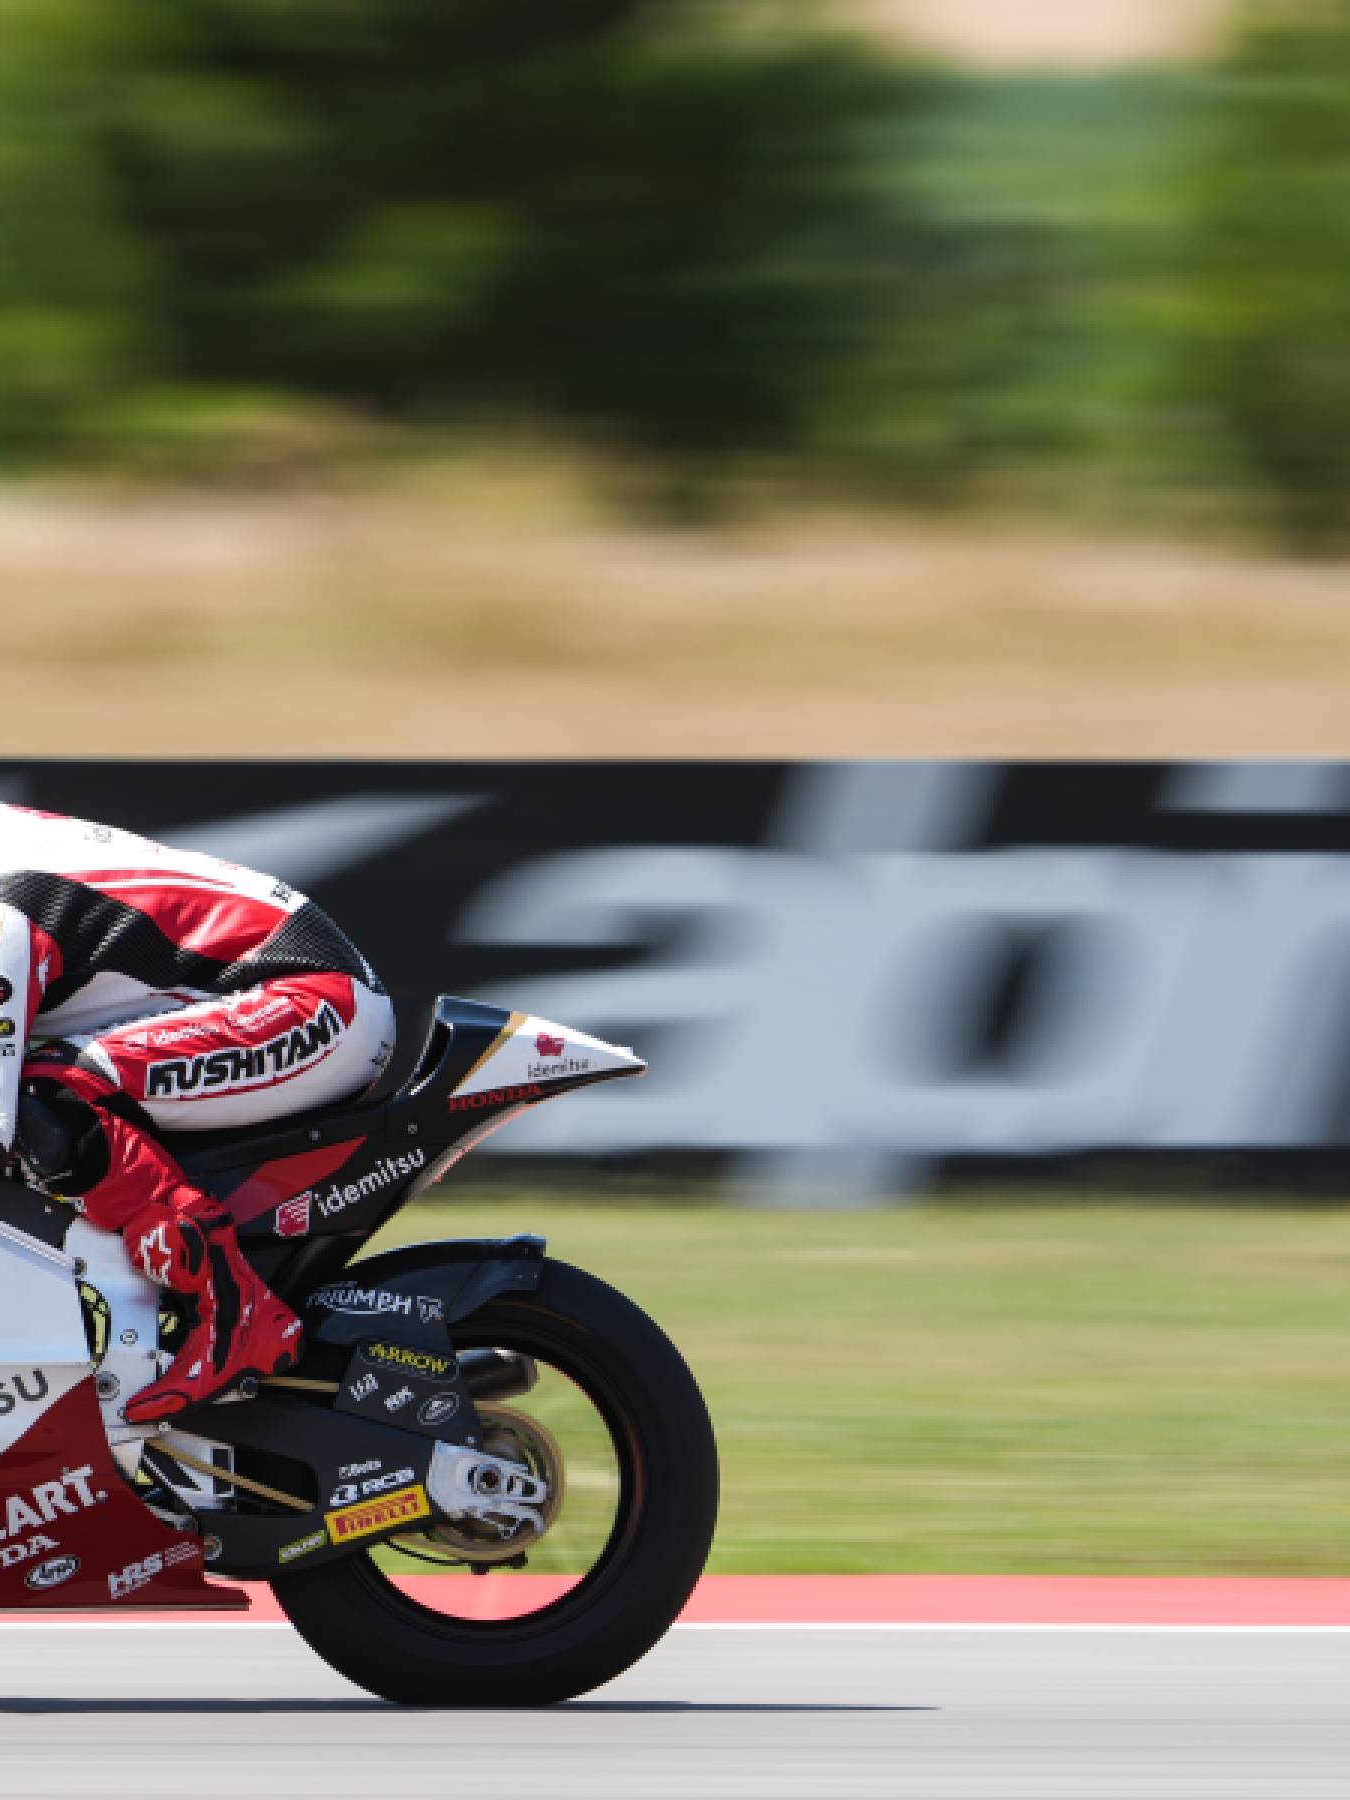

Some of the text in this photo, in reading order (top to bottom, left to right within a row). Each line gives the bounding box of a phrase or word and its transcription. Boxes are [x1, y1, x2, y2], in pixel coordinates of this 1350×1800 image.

[449, 1083, 542, 1111] HONDA
[314, 1147, 425, 1218] idemitsu
[368, 1343, 451, 1374] ARROW
[334, 1493, 421, 1537] PIRELLI
